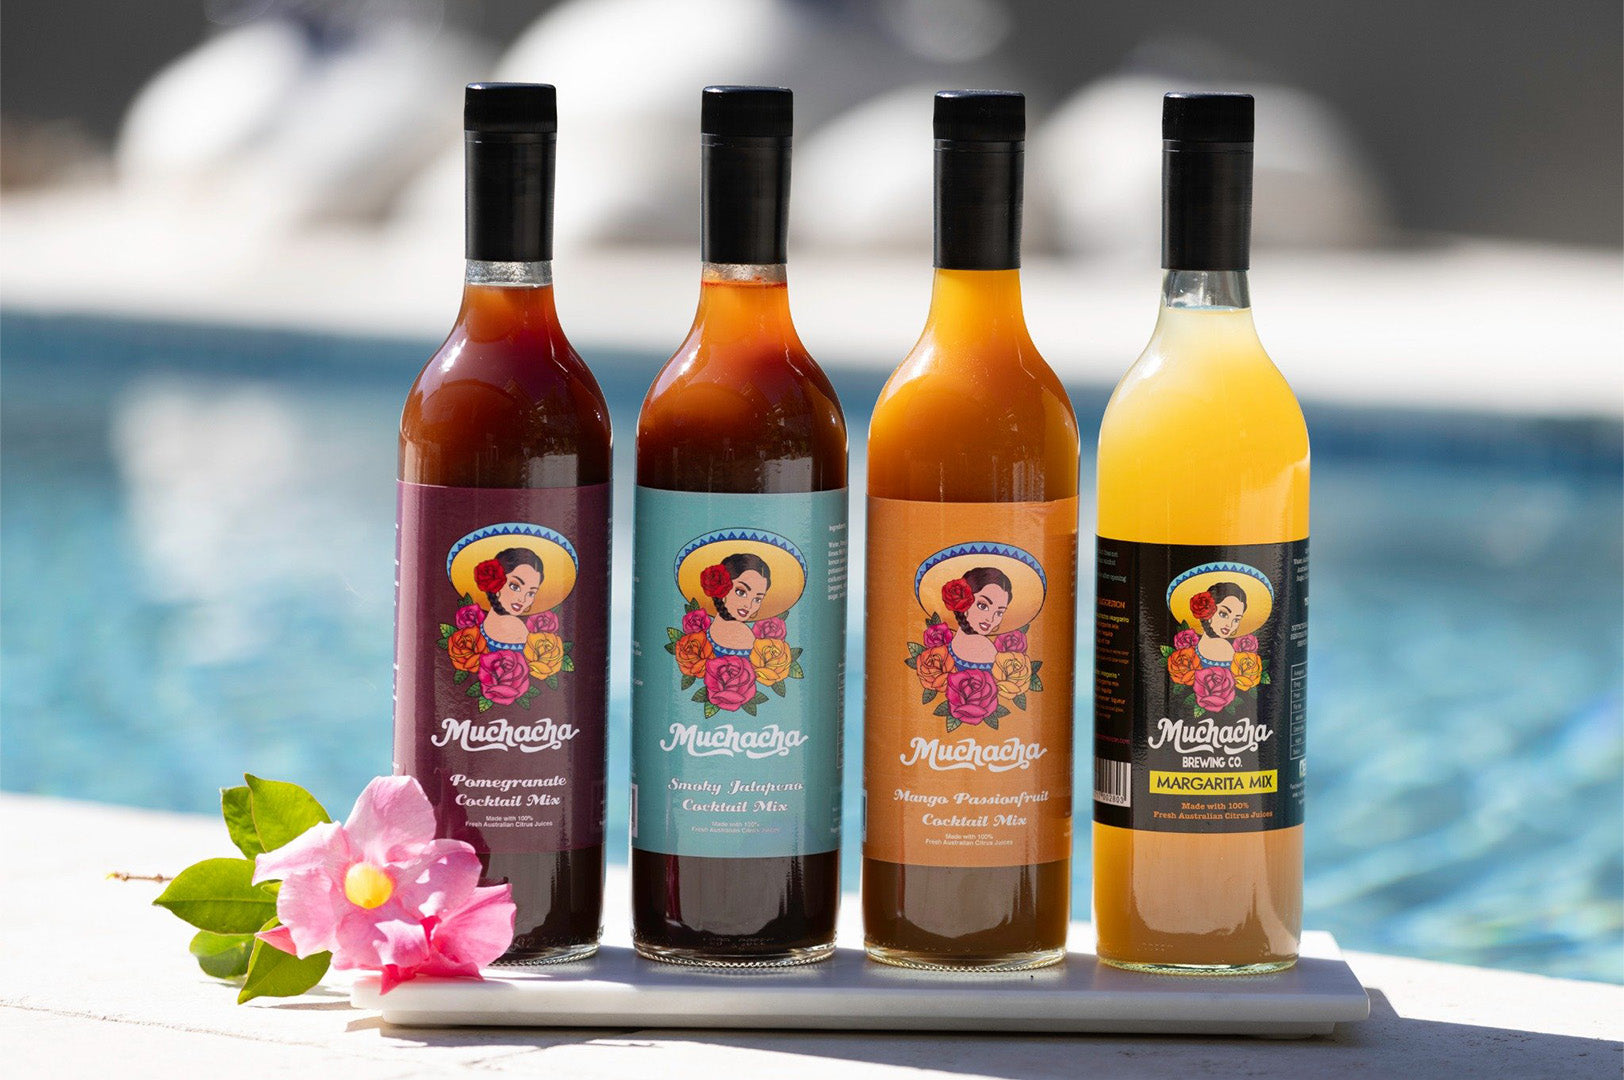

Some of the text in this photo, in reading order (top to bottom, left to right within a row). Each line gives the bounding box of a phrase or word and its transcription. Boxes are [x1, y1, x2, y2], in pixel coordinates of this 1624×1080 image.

[430, 718, 580, 753] Muchacha
[659, 722, 809, 759] Muchacha
[1147, 717, 1274, 755] Muchacha
[899, 736, 1048, 773] Muchacha
[1182, 756, 1243, 768] BREWING CO.
[450, 774, 567, 792] Pomegranate
[667, 777, 804, 796] Smoky Jalapeno
[1156, 774, 1273, 791] MARGARITA MIX
[455, 793, 561, 807] Cocktail Mix
[682, 798, 788, 813] Cocktail Mix
[893, 788, 1049, 808] Mango Passionfruit
[1181, 802, 1249, 810] Made with 100%
[921, 812, 1027, 828] Cocktail Mix
[1153, 810, 1273, 820] Fresh Australian Citrus Juices
